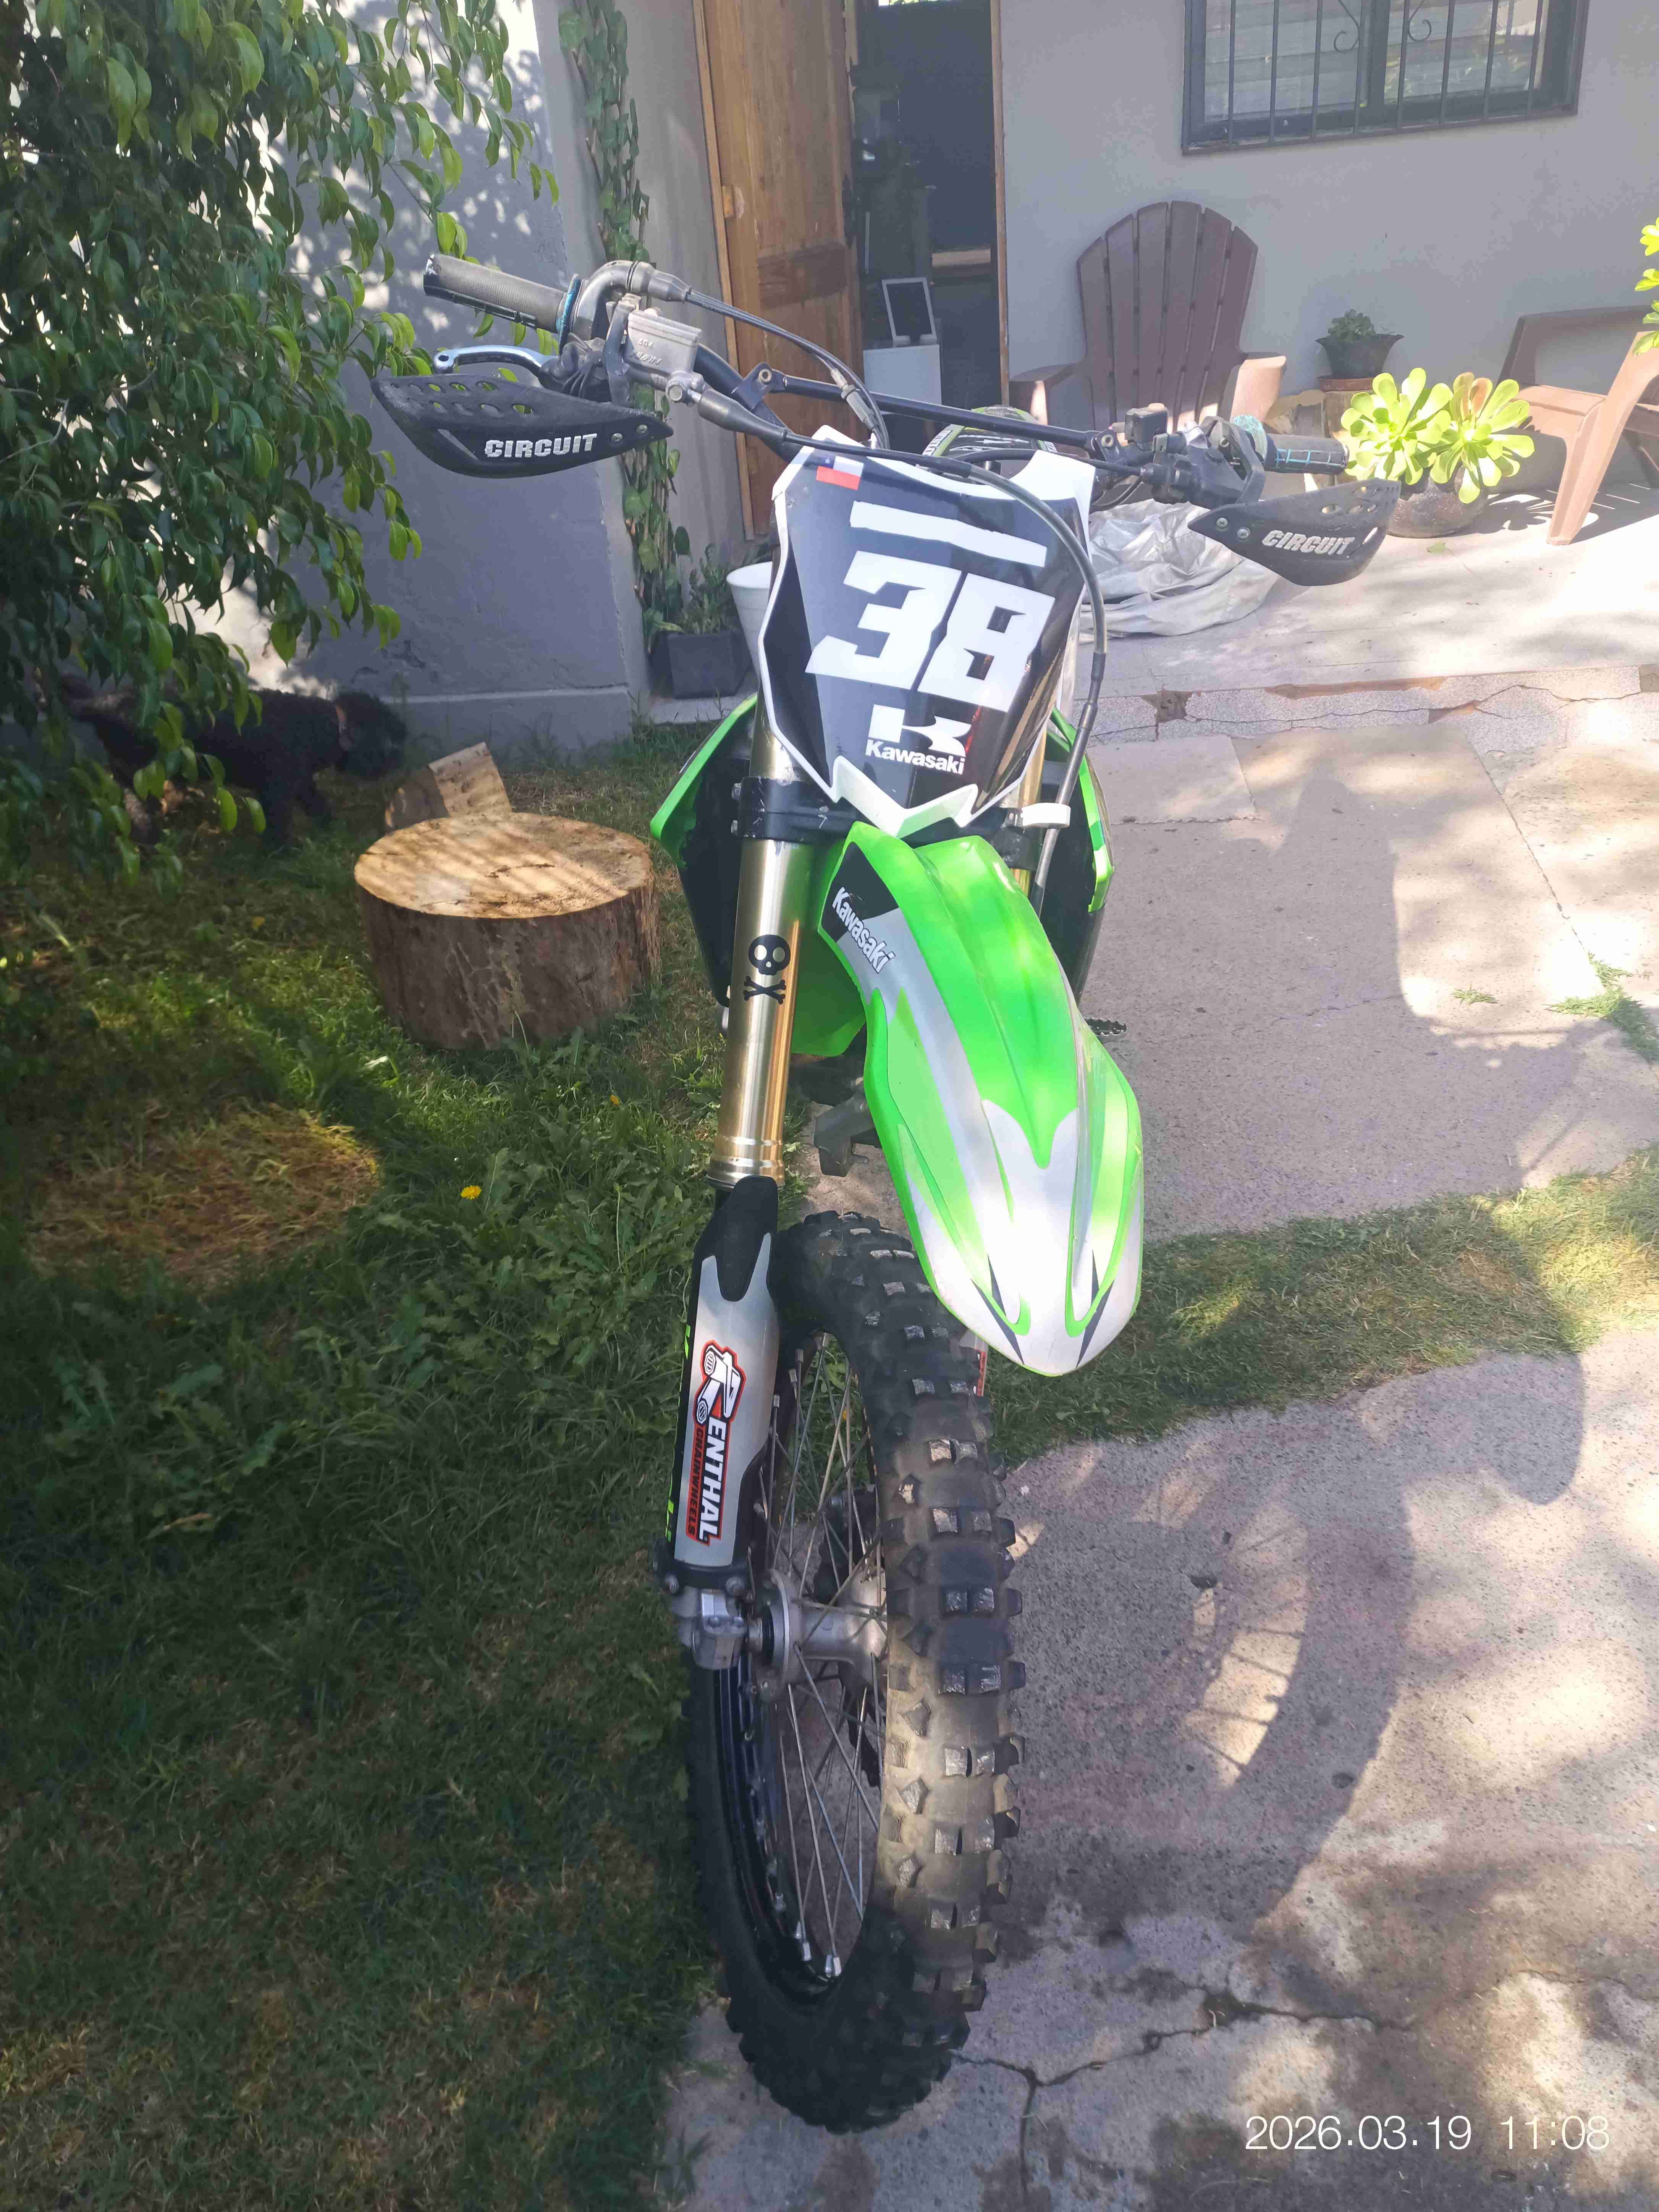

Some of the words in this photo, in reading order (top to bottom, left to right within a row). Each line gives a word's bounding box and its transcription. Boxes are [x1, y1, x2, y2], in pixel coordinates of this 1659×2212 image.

[484, 433, 597, 458] CIRCUIT
[1262, 530, 1355, 555] CIRCUIT
[805, 550, 1056, 712] 38
[865, 739, 966, 775] Kawasaki
[832, 886, 896, 974] Kawasaki
